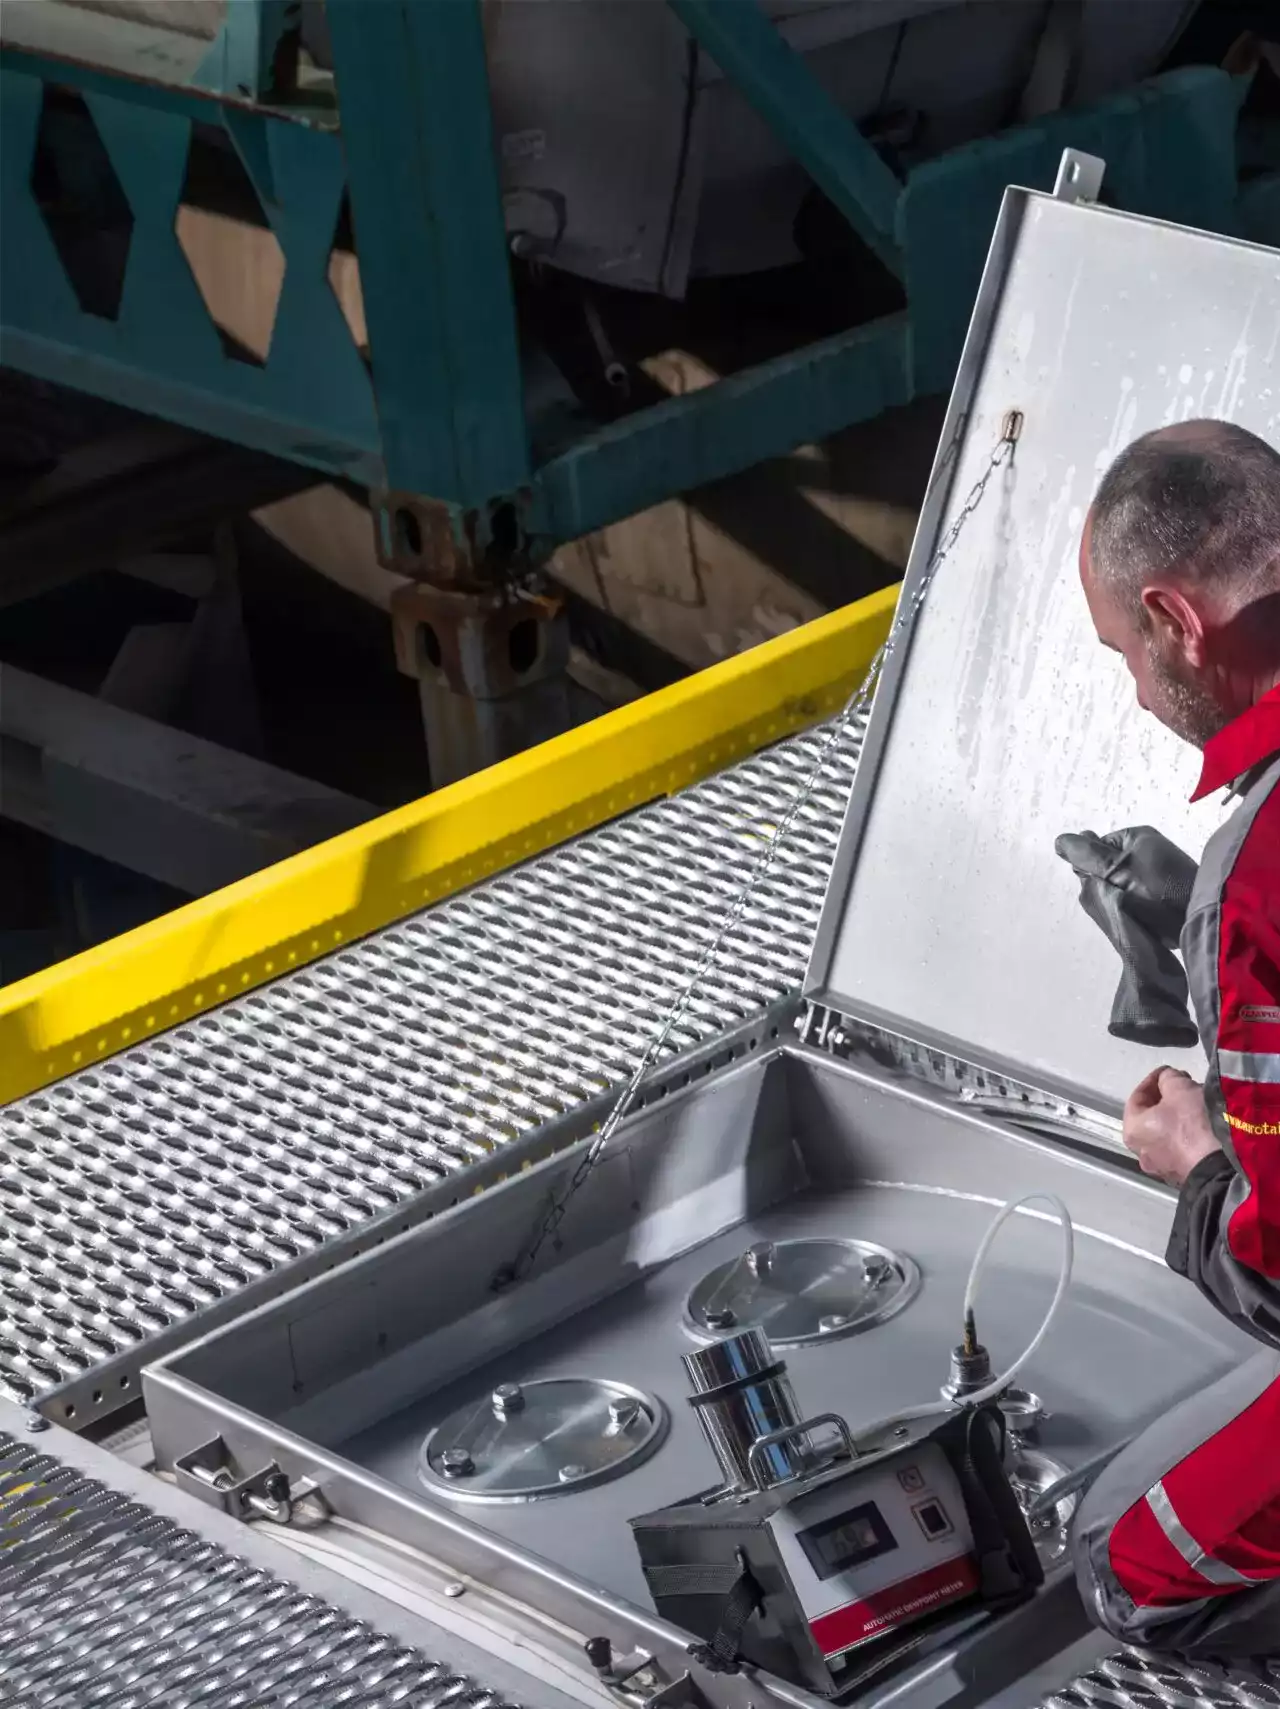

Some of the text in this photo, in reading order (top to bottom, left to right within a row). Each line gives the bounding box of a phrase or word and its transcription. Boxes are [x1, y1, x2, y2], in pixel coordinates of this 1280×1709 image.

[863, 1580, 964, 1632] AUTOMATIC DEWPOINT METER
